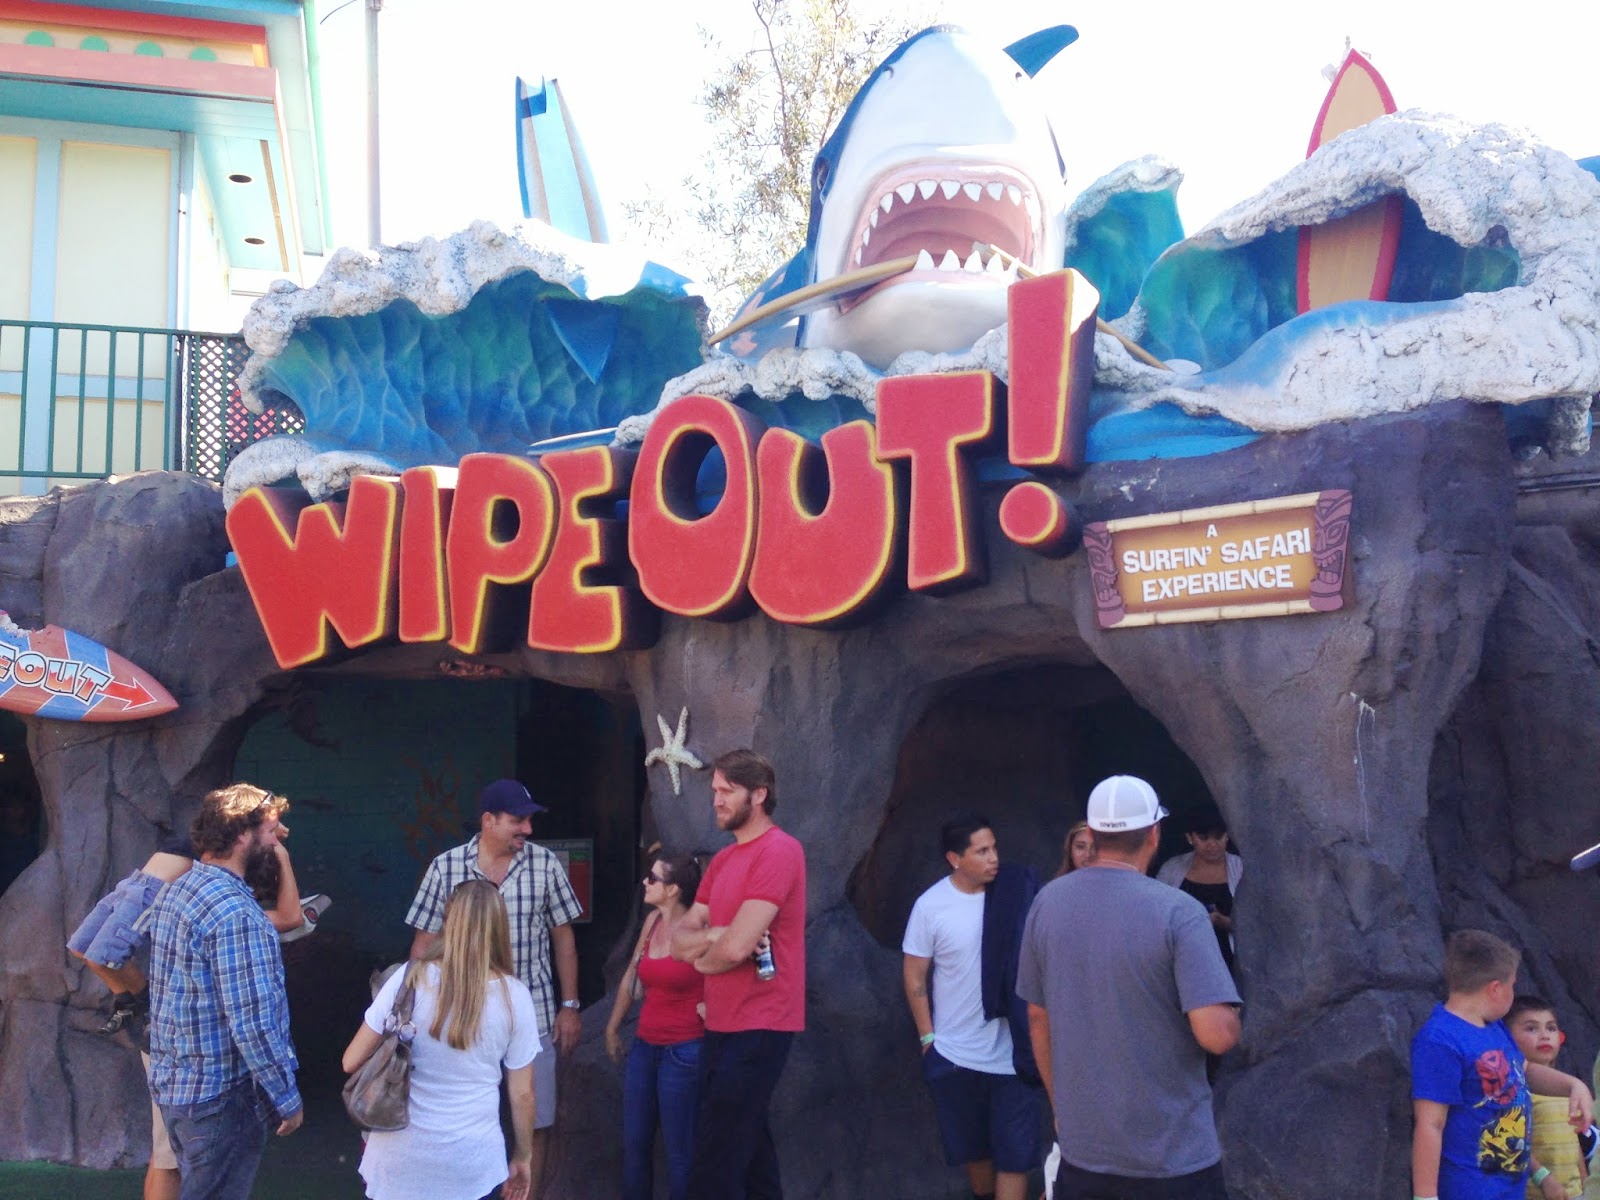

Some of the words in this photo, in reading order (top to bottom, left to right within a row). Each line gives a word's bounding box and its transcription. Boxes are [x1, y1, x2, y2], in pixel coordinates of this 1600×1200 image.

[225, 268, 1078, 669] WIPEOUT!
[1122, 546, 1212, 574] SURFIN'
[1220, 528, 1312, 564] SAFARI
[1206, 524, 1218, 539] A
[1142, 564, 1294, 602] EXPERIENCE
